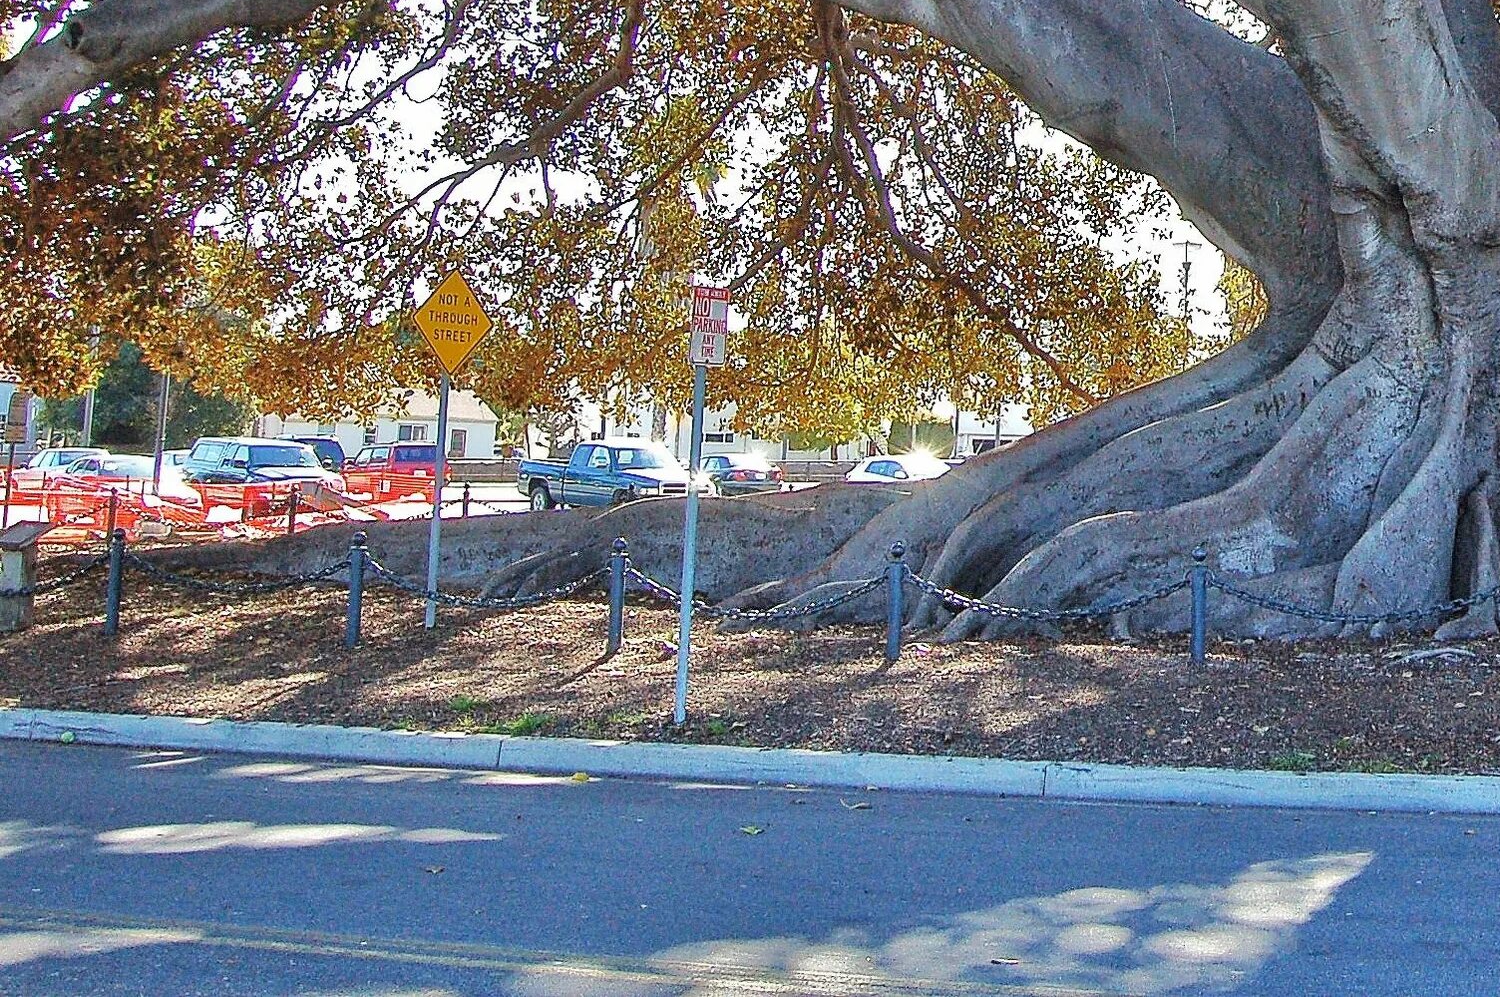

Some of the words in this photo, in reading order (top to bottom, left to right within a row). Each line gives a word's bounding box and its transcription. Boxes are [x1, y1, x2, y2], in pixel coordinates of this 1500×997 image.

[438, 293, 459, 306] NOT
[464, 296, 471, 308] A
[695, 297, 709, 317] NO
[428, 310, 478, 326] THROUGH
[694, 317, 727, 334] PARKING
[433, 328, 472, 343] STREET
